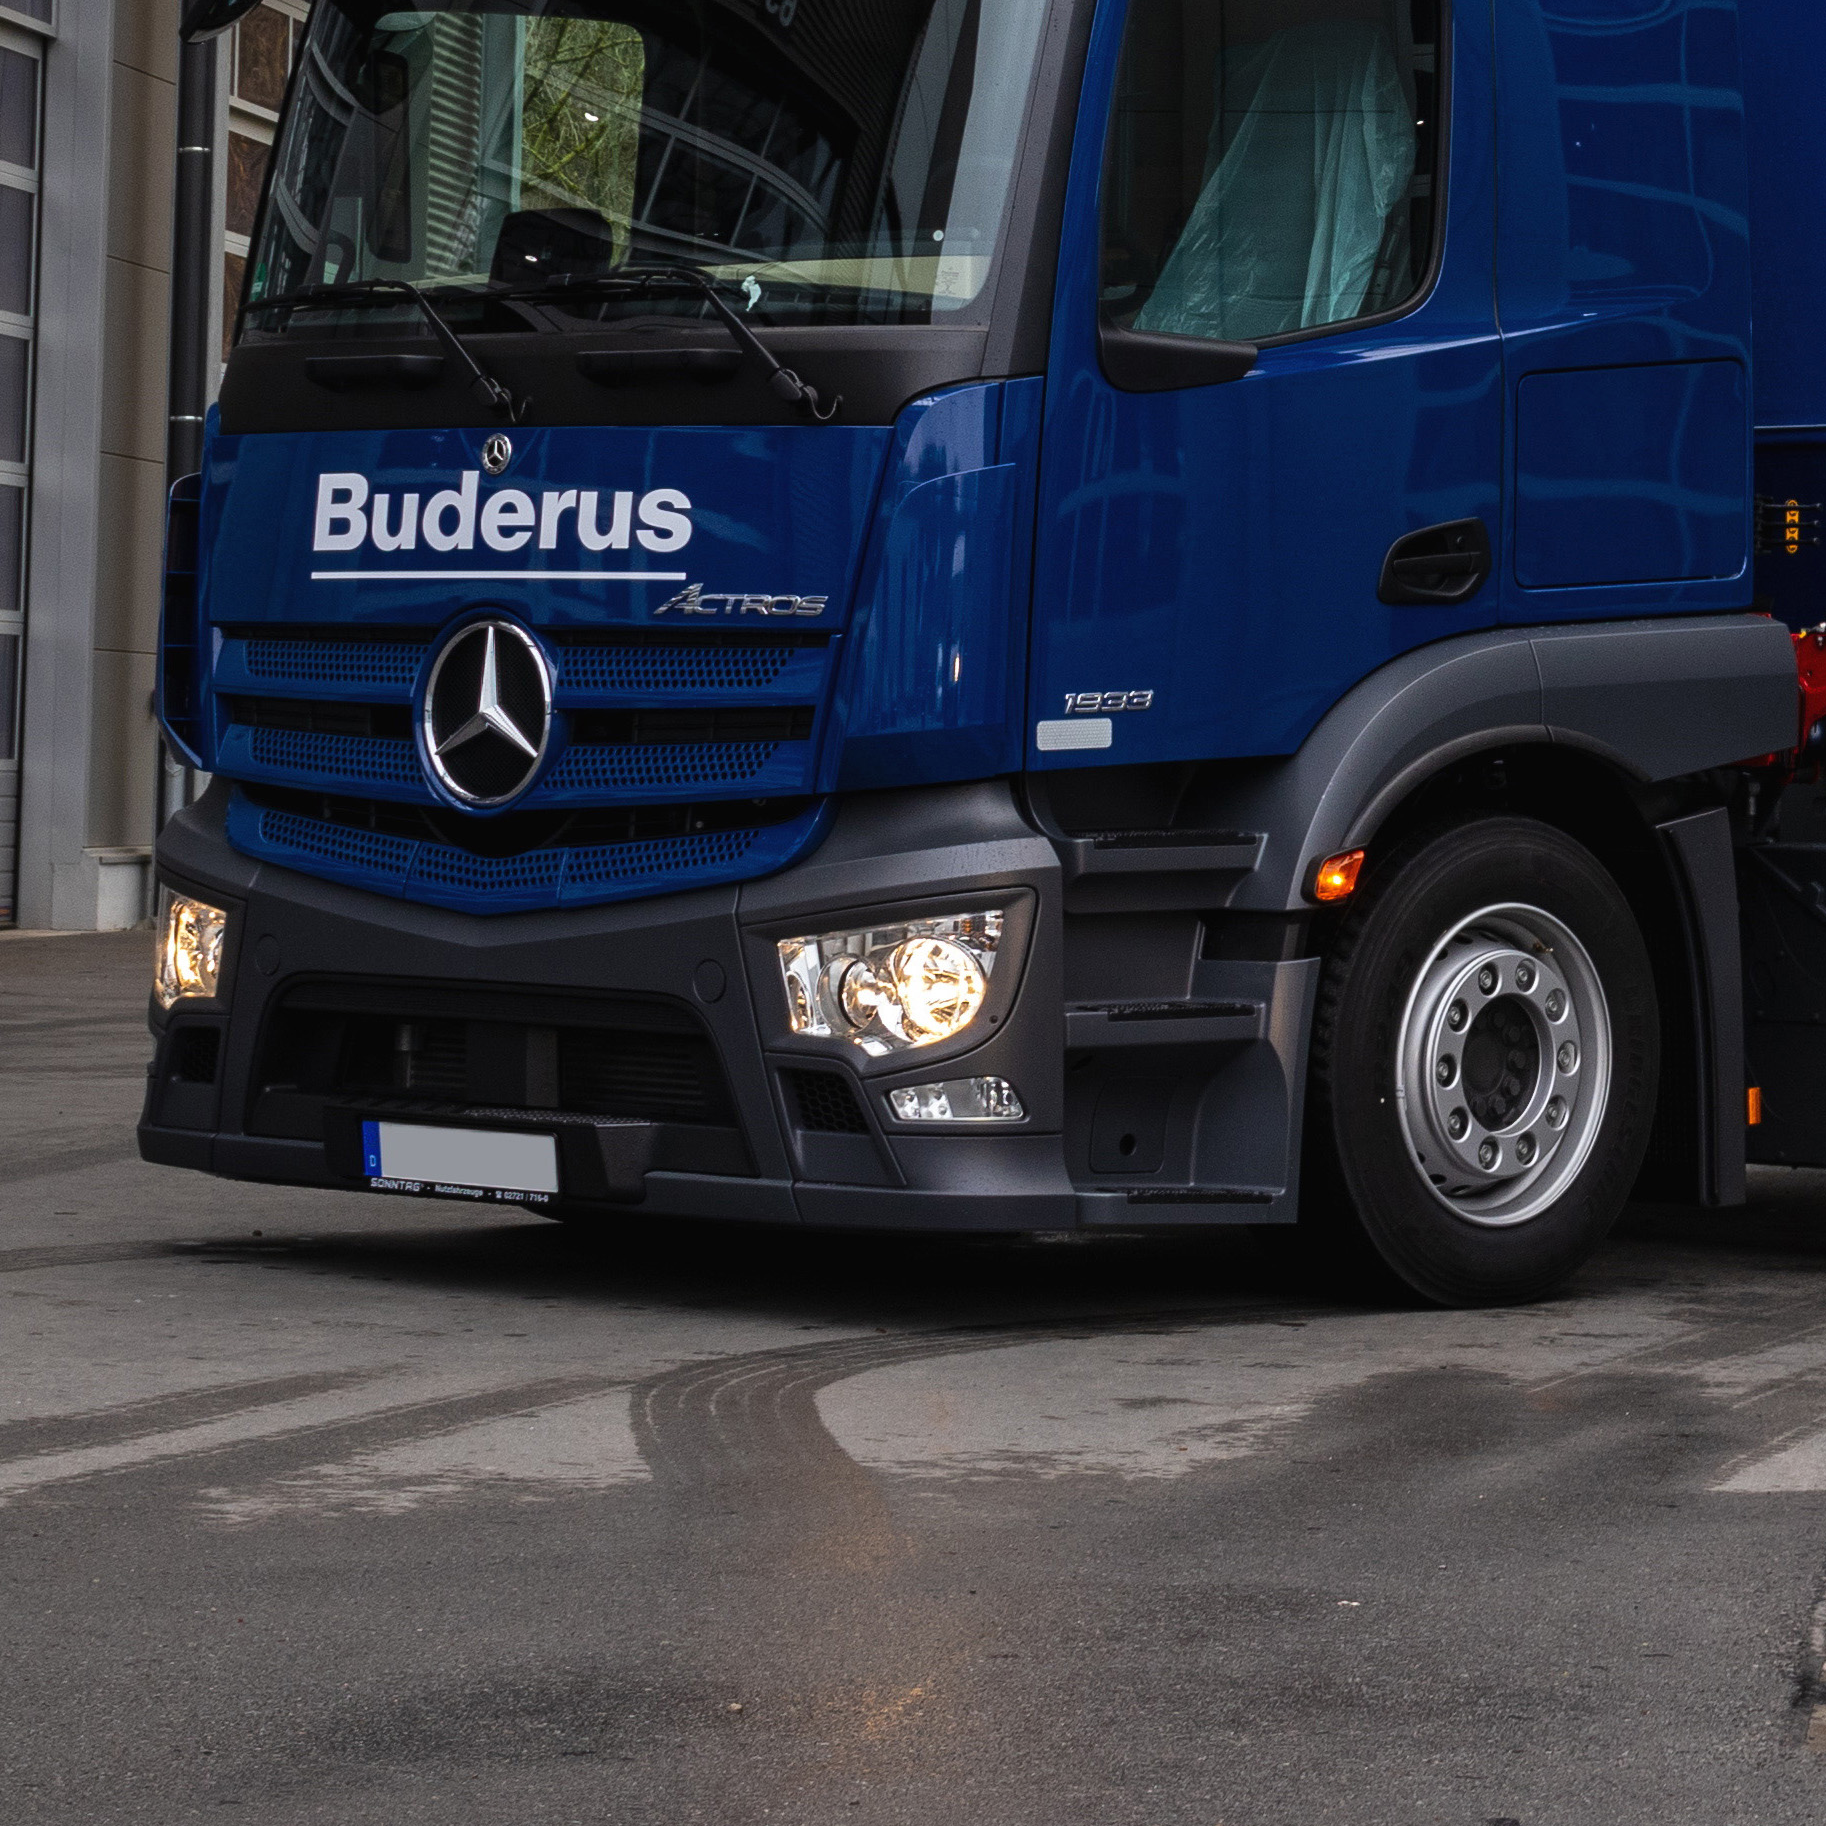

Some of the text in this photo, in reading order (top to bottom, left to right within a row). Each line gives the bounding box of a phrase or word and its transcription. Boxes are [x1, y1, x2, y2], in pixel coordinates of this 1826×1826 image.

[313, 470, 692, 552] Buderus
[1065, 689, 1154, 714] 1933
[369, 1154, 377, 1167] D
